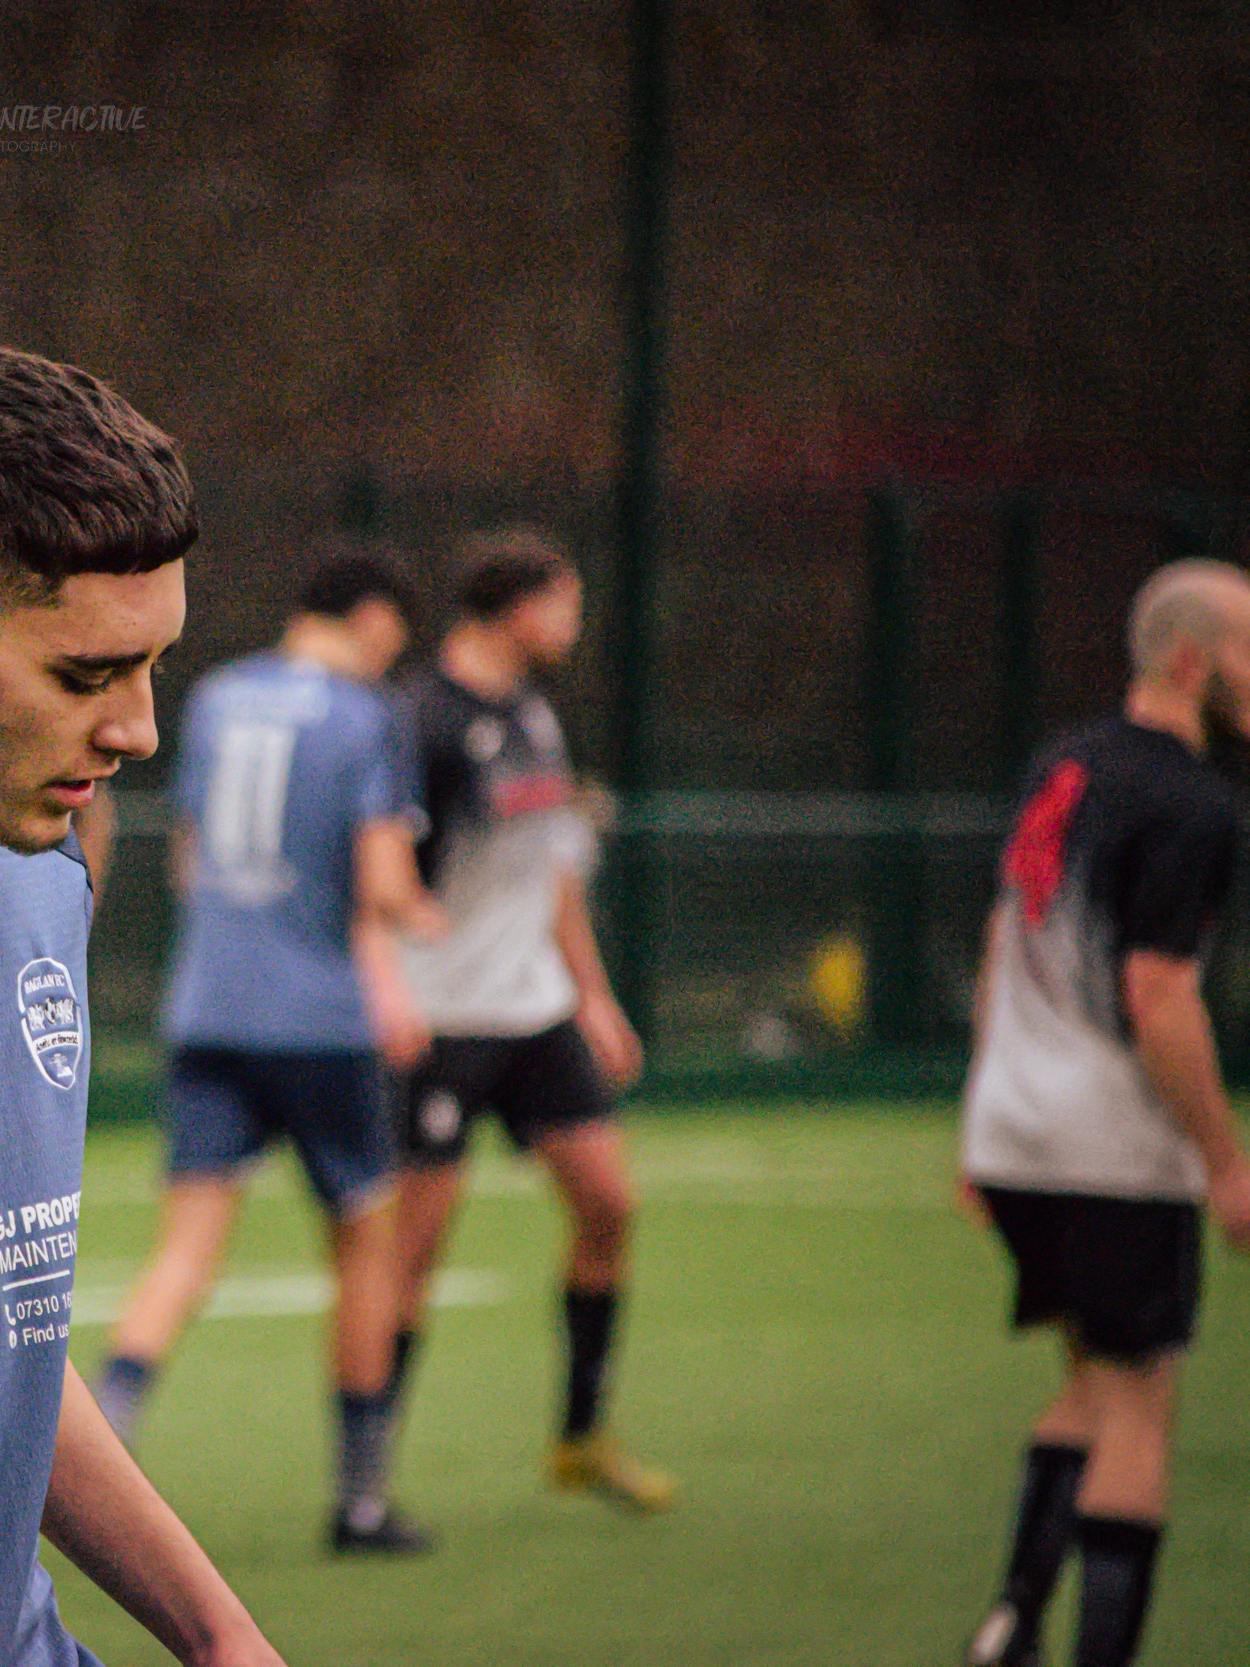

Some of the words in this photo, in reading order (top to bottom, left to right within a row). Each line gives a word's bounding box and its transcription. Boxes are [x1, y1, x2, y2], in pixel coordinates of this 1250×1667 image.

[16, 1295, 59, 1320] 07310
[23, 1323, 55, 1346] Find
[58, 1323, 69, 1338] us
